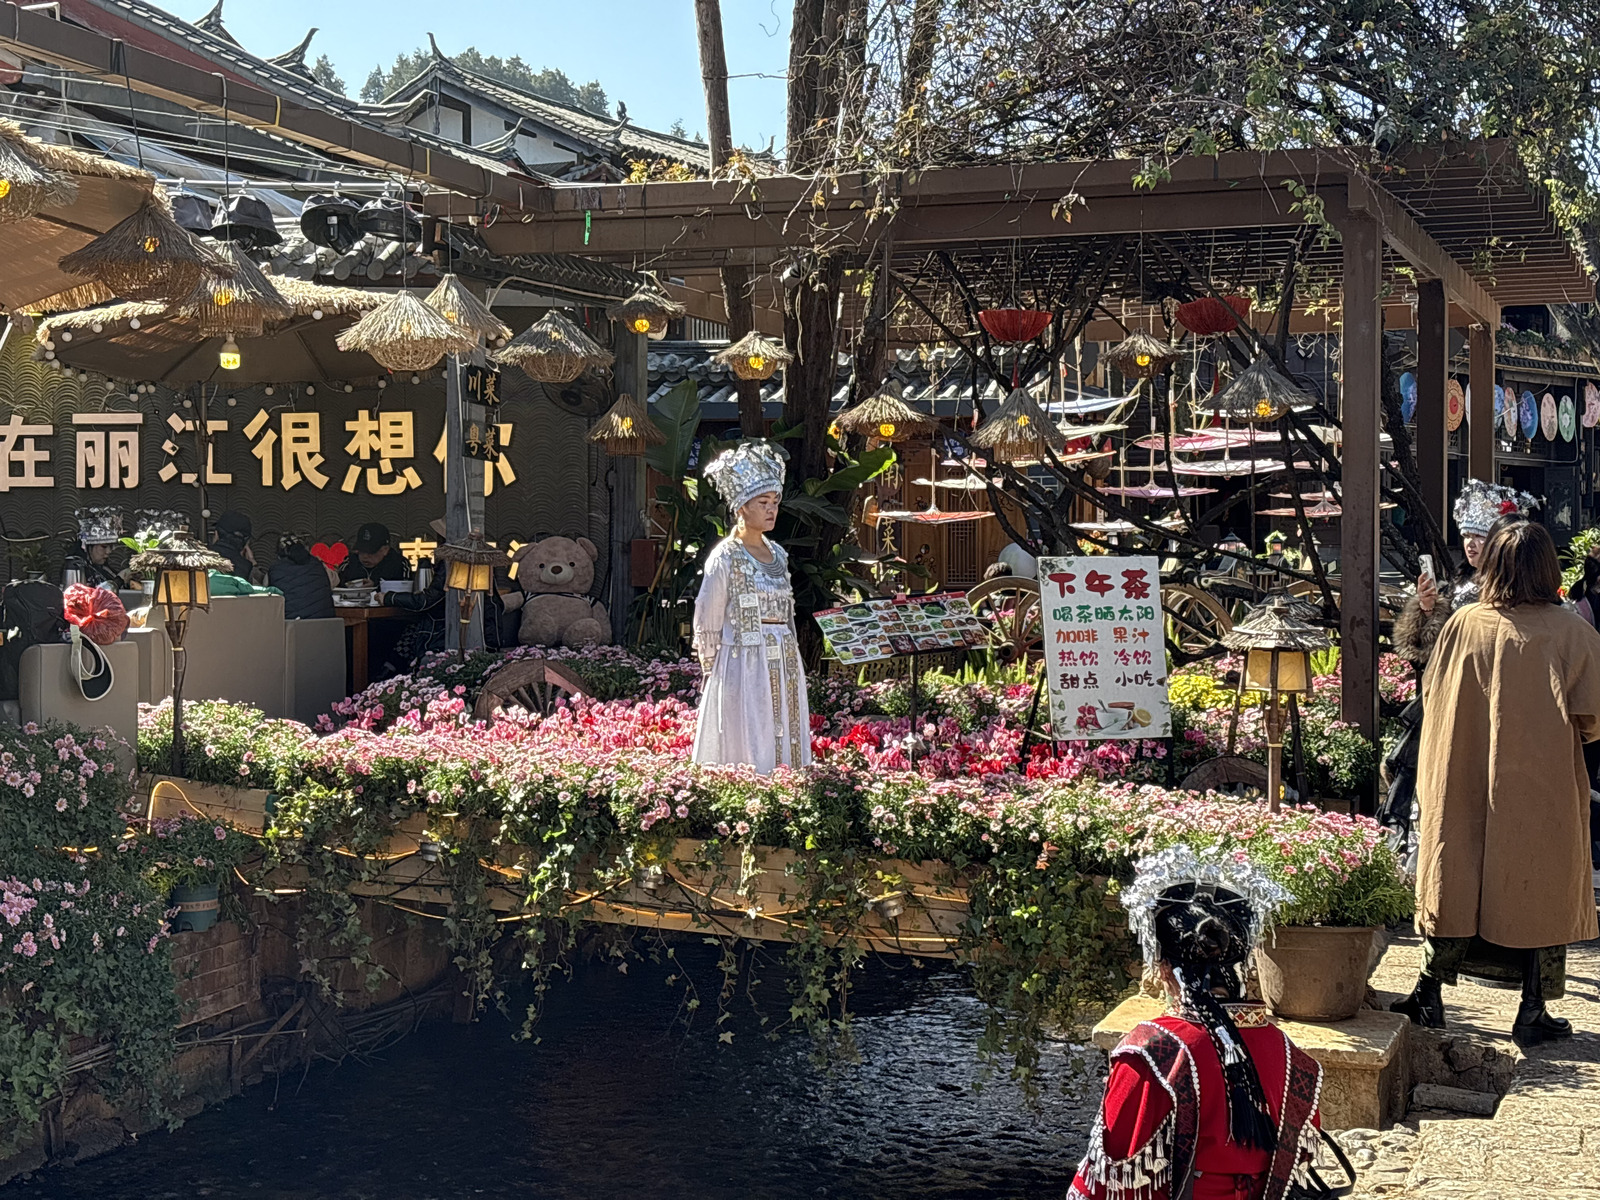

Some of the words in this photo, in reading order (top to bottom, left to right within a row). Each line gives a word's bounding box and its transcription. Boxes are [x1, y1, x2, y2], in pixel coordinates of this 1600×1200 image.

[468, 370, 500, 405] 川菜
[465, 423, 499, 460] 粤菜
[1048, 569, 1151, 600] 下午茶
[1052, 605, 1155, 624] 喝茶晒太阳
[1113, 627, 1150, 644] 果汁
[1058, 649, 1099, 667] 热饮
[1113, 648, 1152, 667] 冷饮
[1059, 671, 1099, 690] 甜点
[1115, 670, 1155, 688] 小吃
